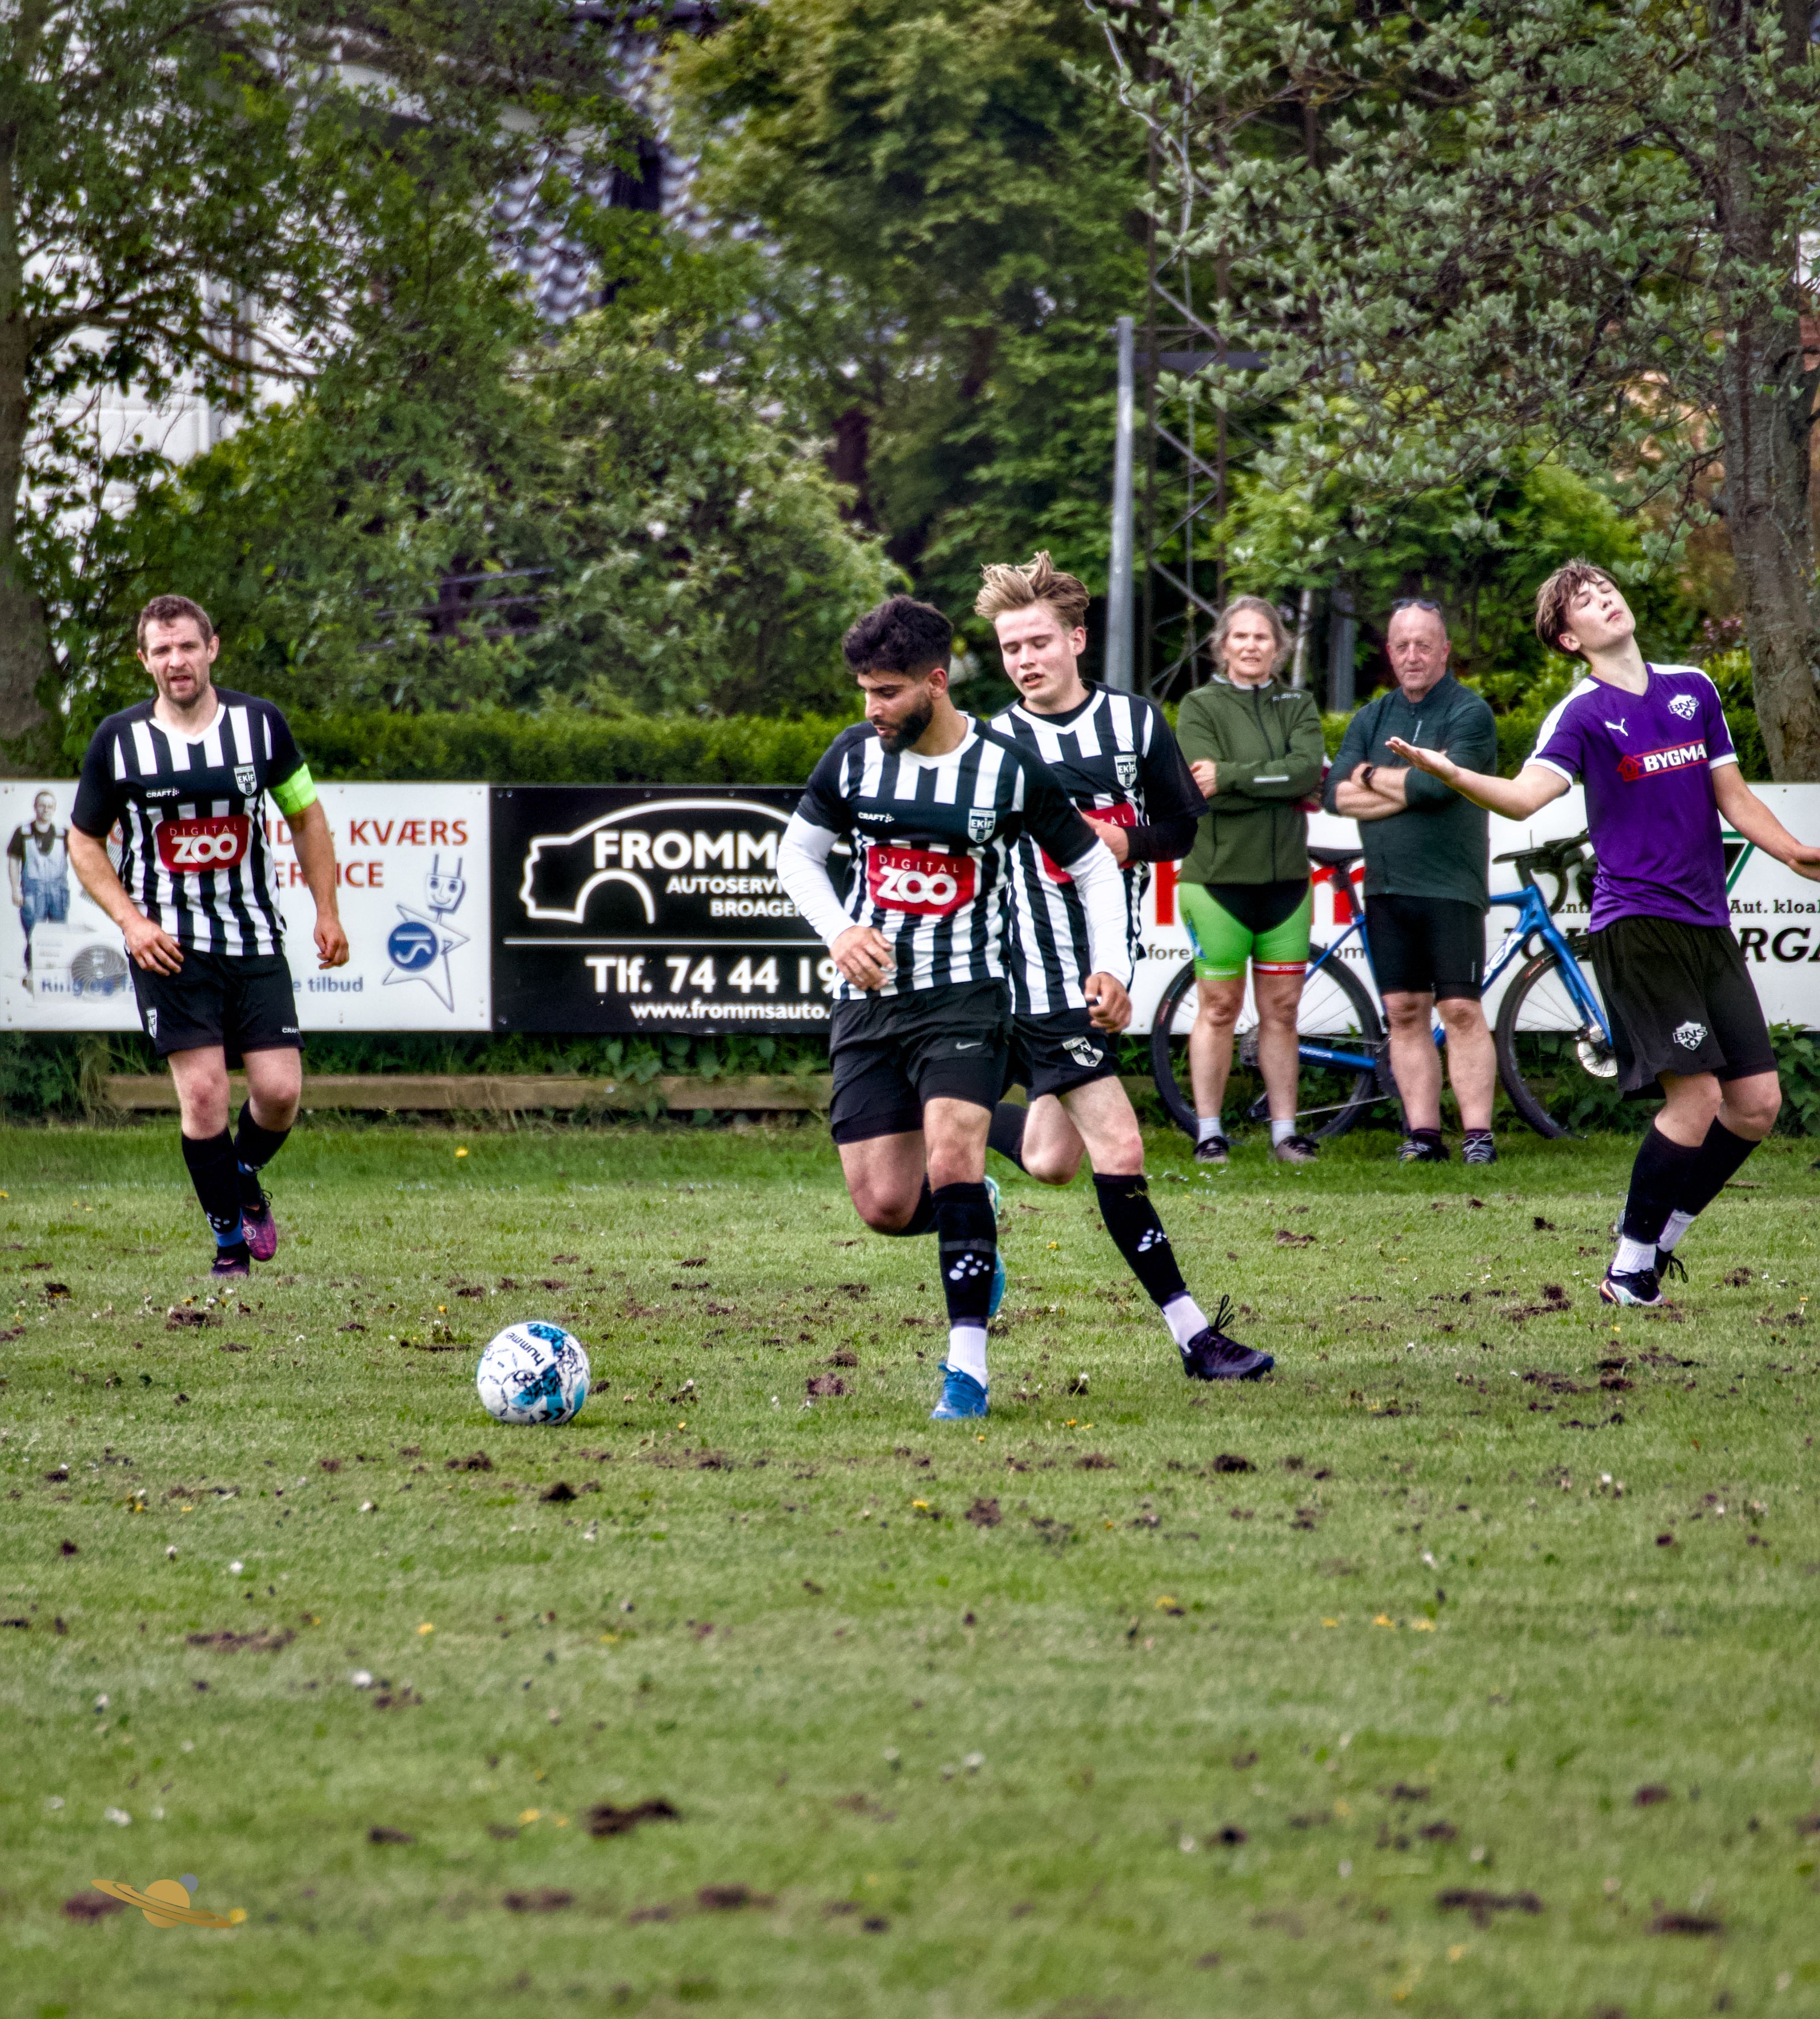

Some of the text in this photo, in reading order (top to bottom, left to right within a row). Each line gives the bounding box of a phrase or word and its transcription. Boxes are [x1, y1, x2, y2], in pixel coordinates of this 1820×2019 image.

[1669, 697, 1699, 713] BNS
[1643, 743, 1707, 772] BYGMA
[1118, 762, 1136, 773] EKIF
[238, 772, 255, 783] EKIF
[146, 789, 172, 799] CRAFT
[858, 812, 885, 822] CRAFT
[971, 817, 994, 829] EKIF
[170, 823, 238, 836] DIGITAL
[350, 820, 469, 846] KVÆRS
[171, 833, 238, 863] ZOO
[594, 831, 779, 870] FROMM
[879, 854, 959, 874] DIGITAL
[275, 862, 384, 888] ERICE
[665, 875, 785, 895] AUTOSERVI
[876, 866, 958, 905] ZOO
[1730, 899, 1768, 913] Aut.
[1773, 899, 1820, 913] kloa
[1148, 944, 1190, 960] fore
[308, 975, 364, 992] tilbud
[585, 957, 837, 994] Tlf. 74 44 19
[629, 998, 830, 1019] www.frommsauto.
[1673, 1027, 1707, 1042] BNS
[505, 1332, 544, 1367] humme
